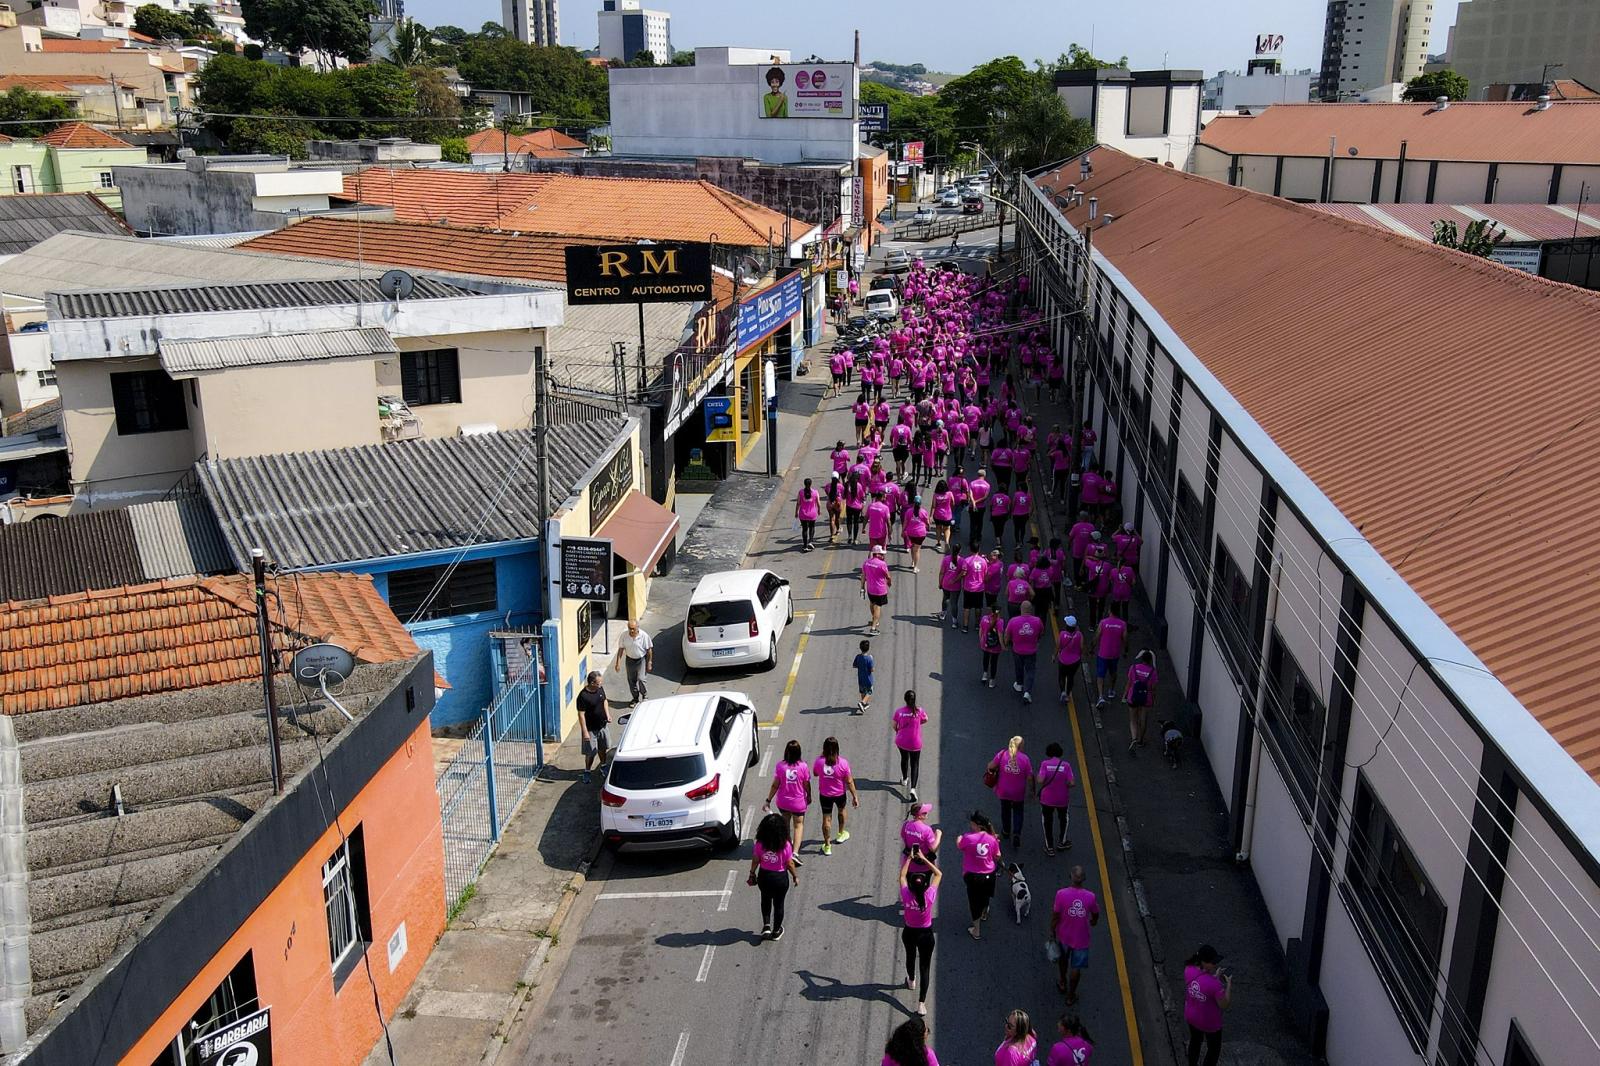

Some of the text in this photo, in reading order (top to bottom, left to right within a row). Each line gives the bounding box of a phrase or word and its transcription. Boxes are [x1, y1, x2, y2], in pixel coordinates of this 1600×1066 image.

[574, 284, 706, 297] CENTRO AUTOMOTIVO
[214, 1014, 268, 1051] BARBEARIA
